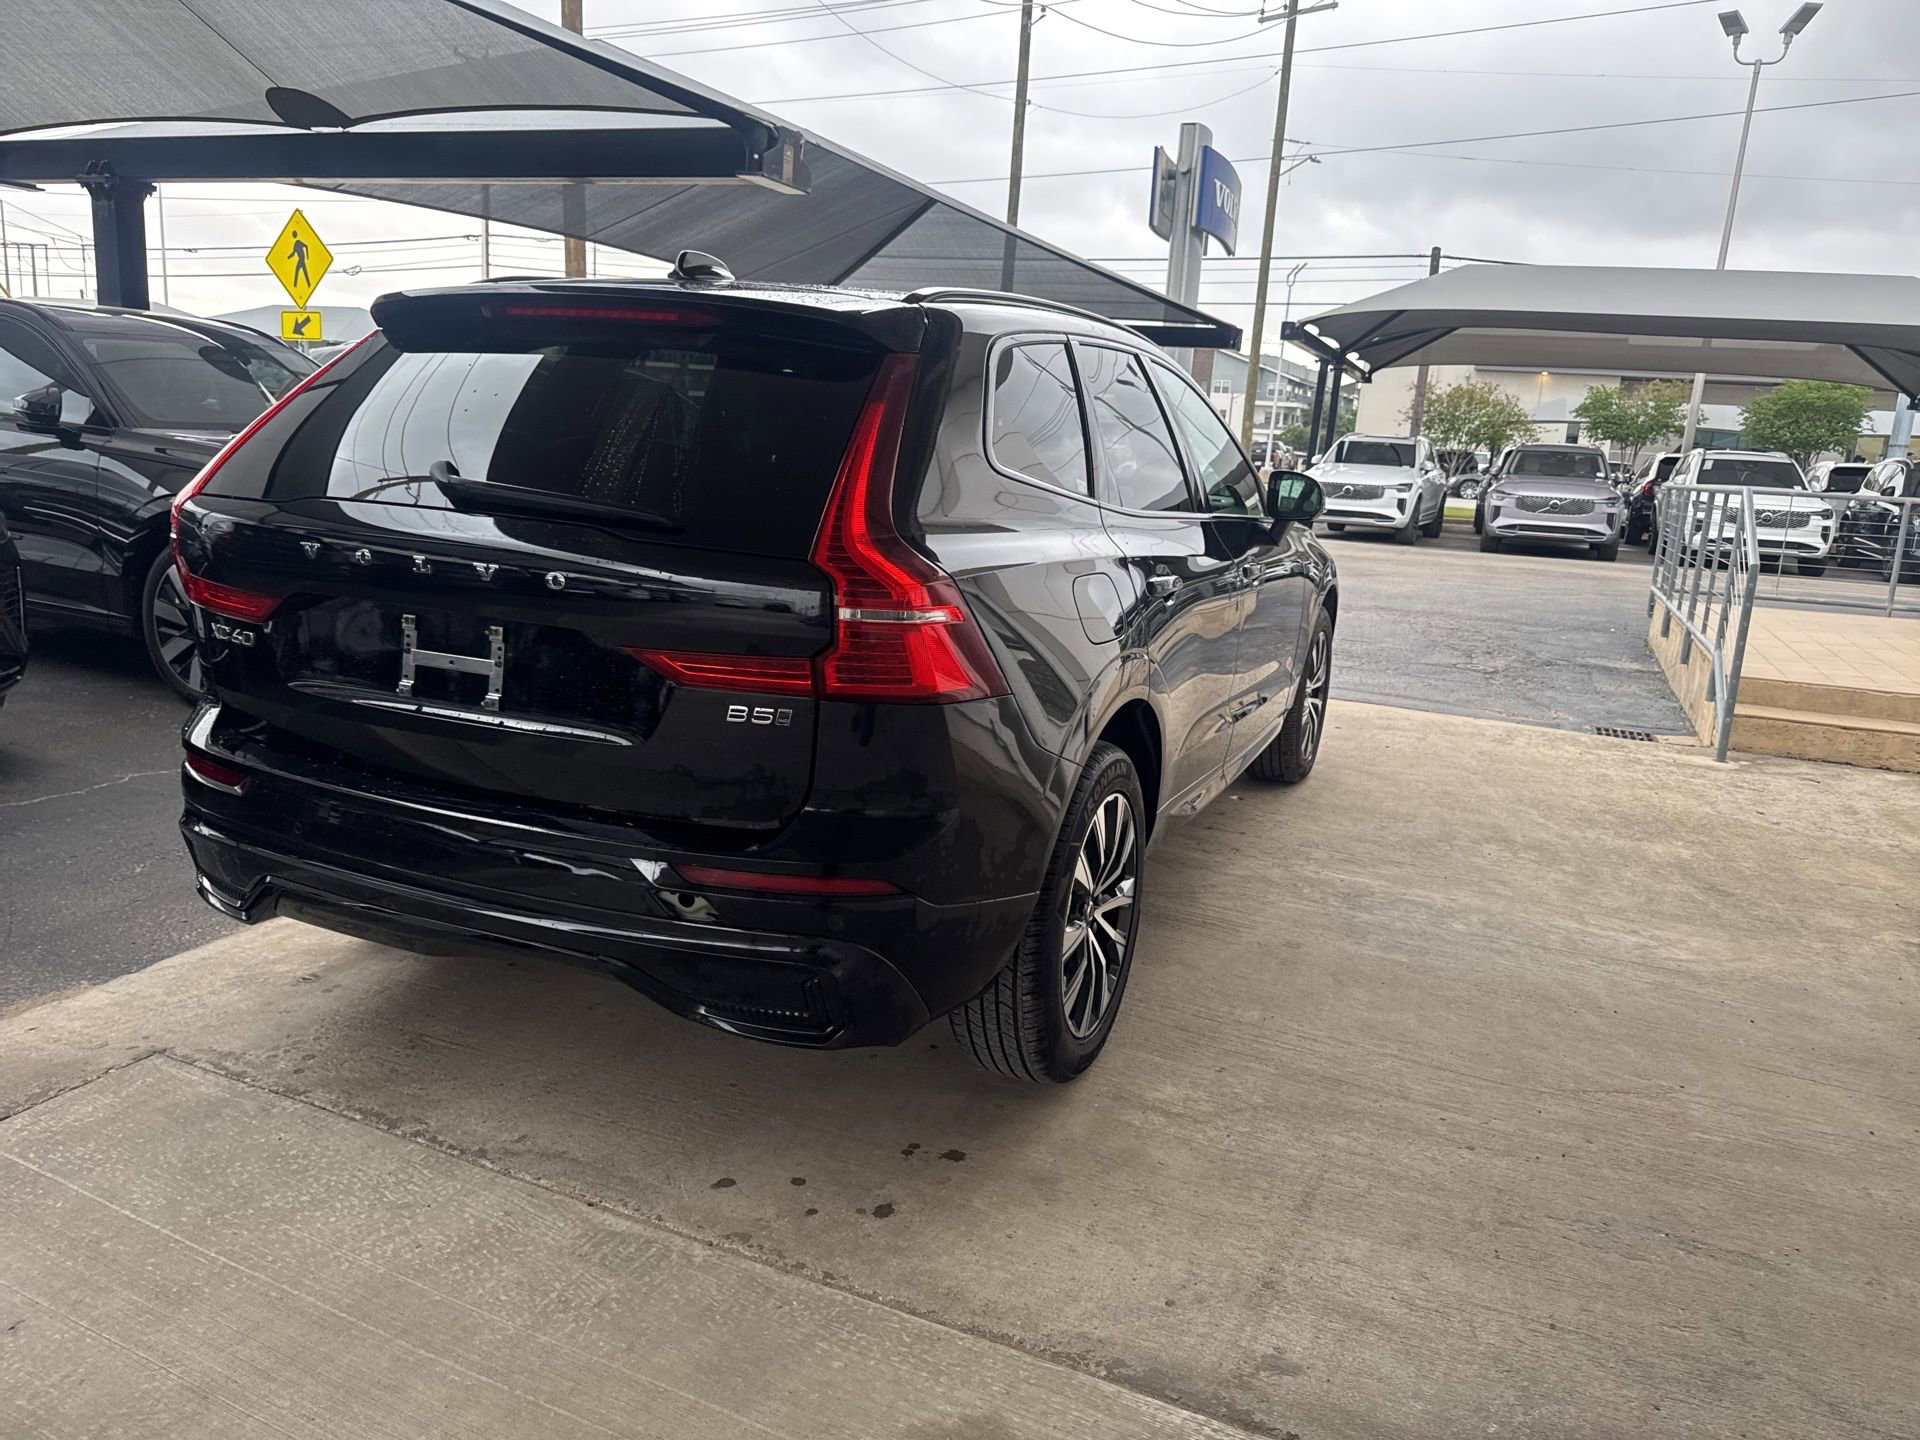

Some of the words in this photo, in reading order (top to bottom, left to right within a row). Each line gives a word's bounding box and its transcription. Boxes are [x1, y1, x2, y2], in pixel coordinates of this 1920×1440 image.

[300, 541, 566, 591] VOLVO
[726, 705, 775, 725] B5
[1084, 762, 1127, 823] IRONMAN
